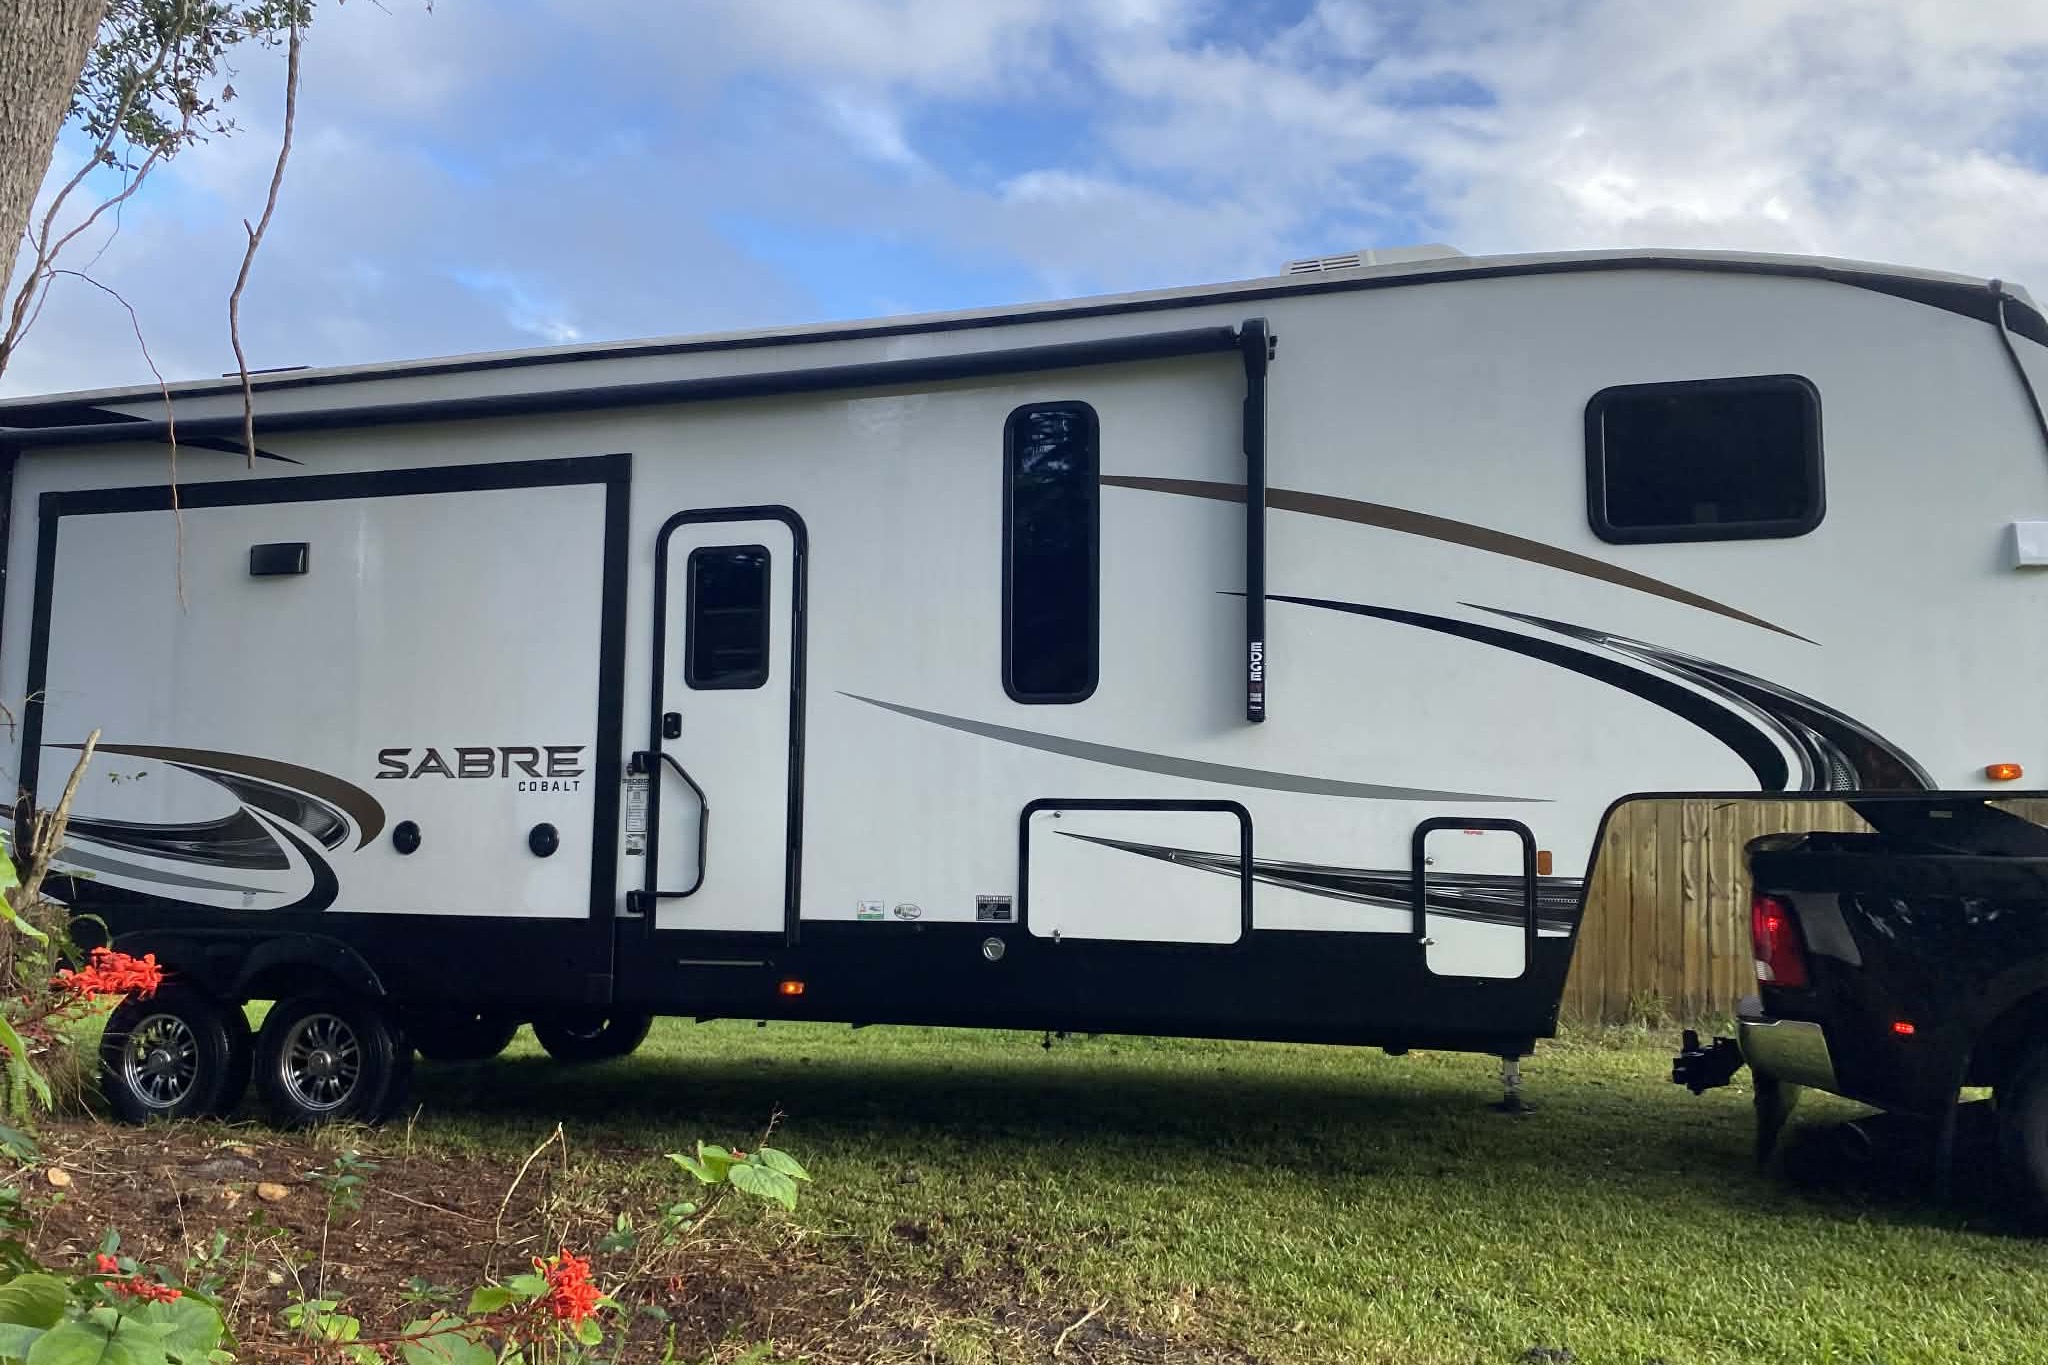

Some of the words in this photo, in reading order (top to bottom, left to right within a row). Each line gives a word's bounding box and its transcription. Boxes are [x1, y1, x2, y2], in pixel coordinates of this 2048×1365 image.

[1250, 642, 1262, 681] EDGE
[375, 746, 586, 779] SABRE
[518, 781, 580, 792] COBALT
